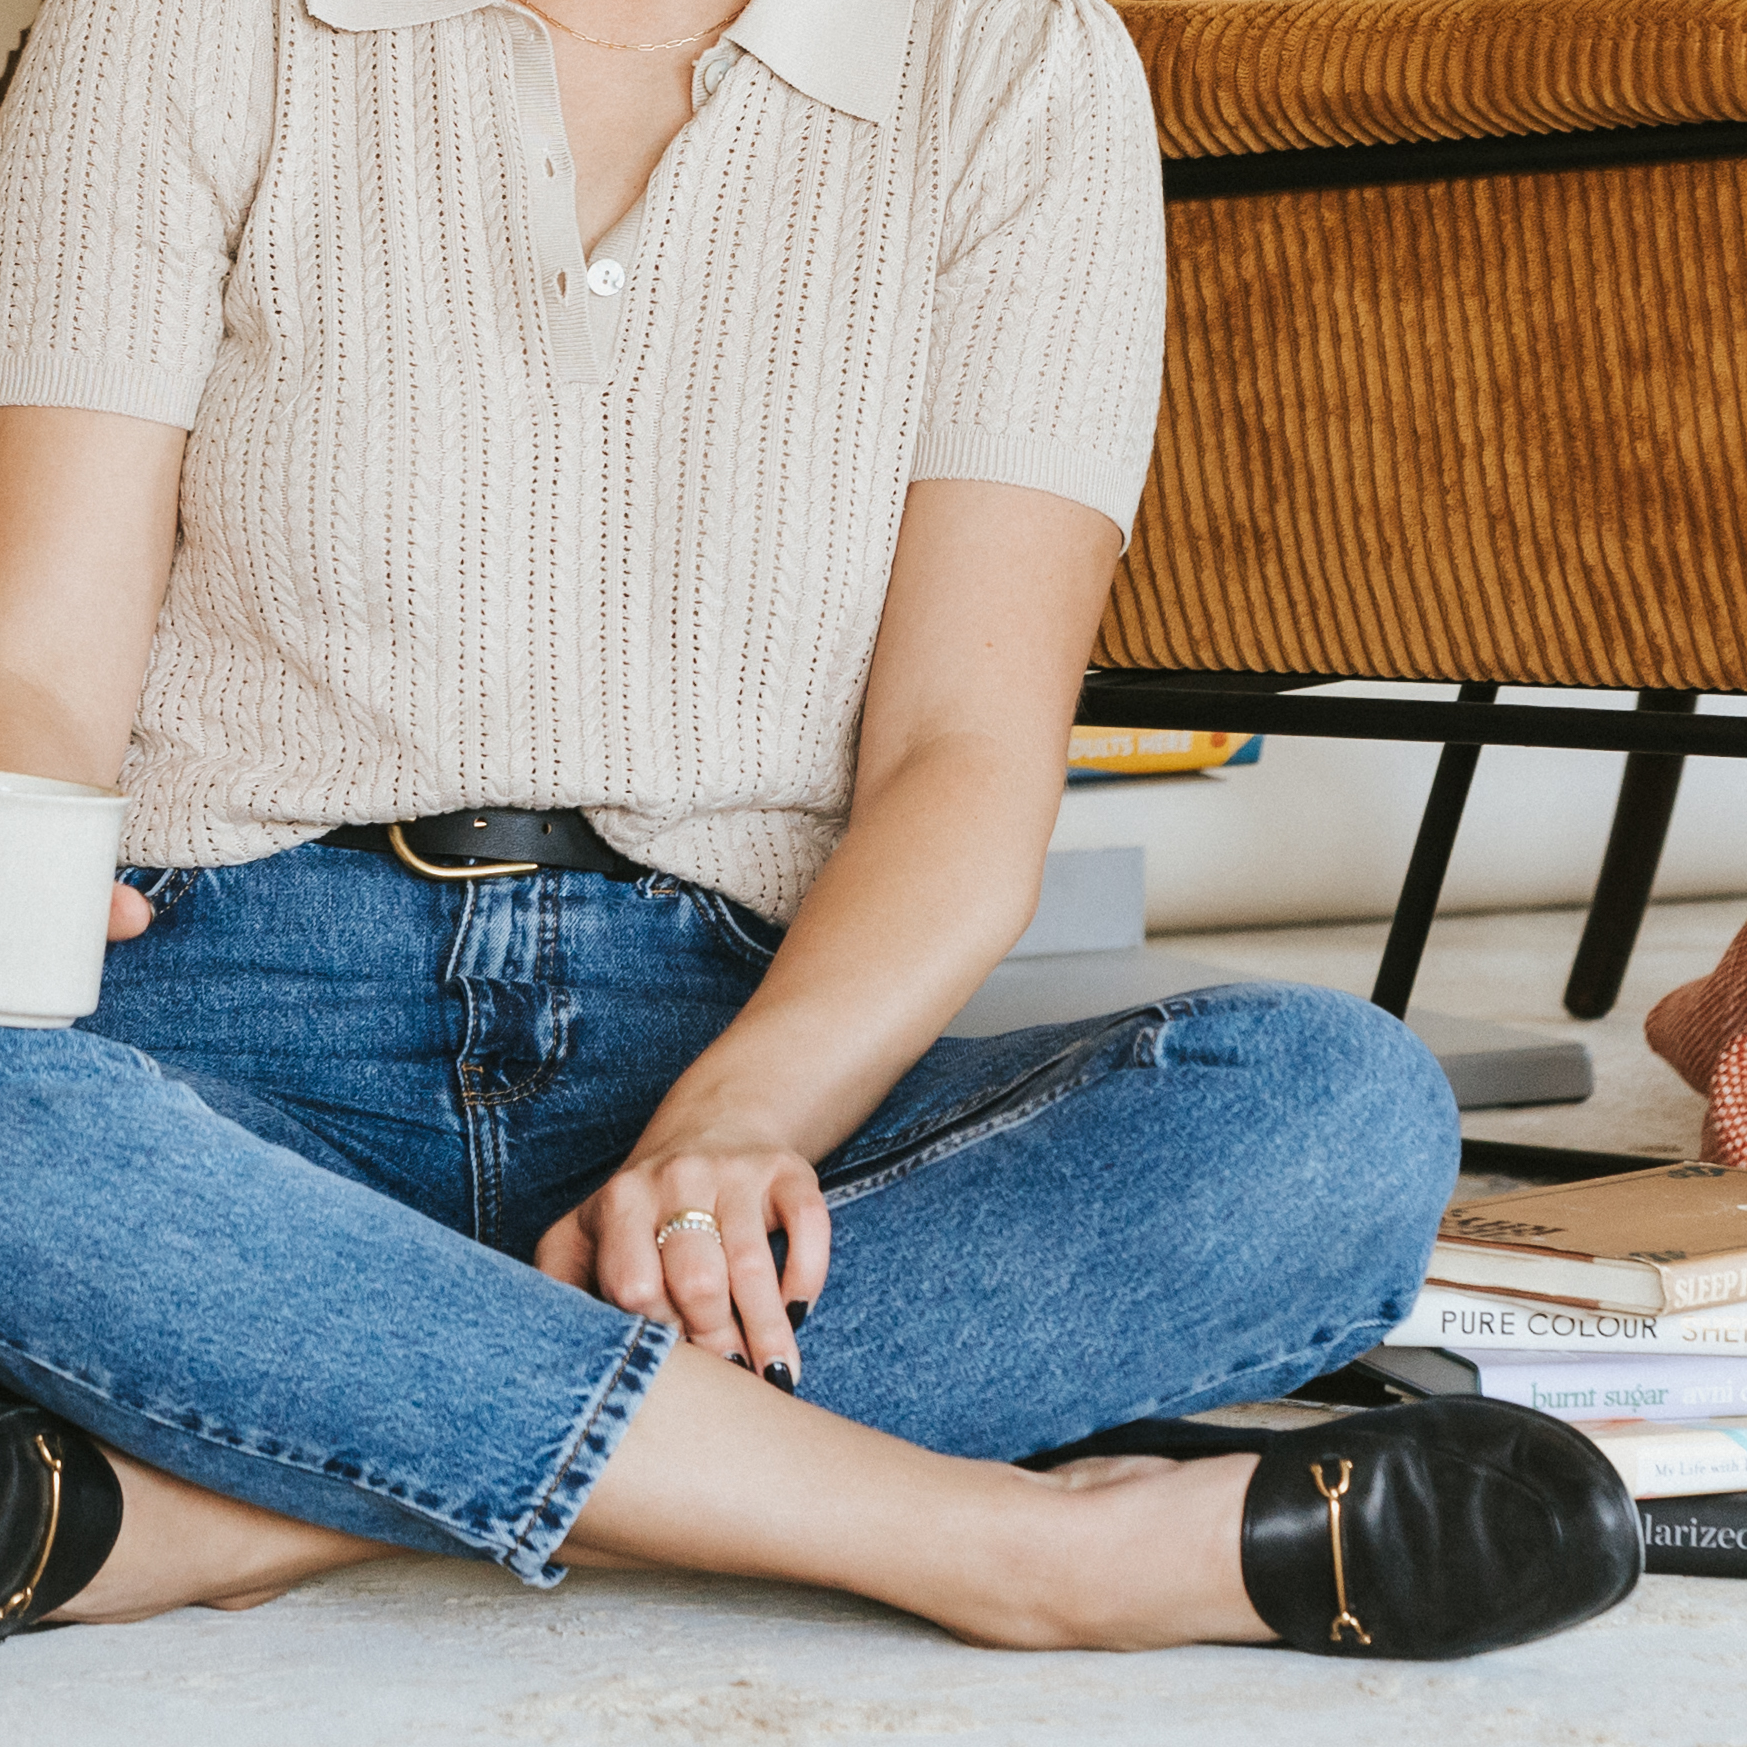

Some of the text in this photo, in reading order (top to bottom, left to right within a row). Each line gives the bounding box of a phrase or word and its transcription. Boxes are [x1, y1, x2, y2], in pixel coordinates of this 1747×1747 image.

[1673, 1266, 1738, 1310] SLEEP
[1441, 1310, 1516, 1336] PURE
[1527, 1311, 1659, 1340] COLOUR
[1530, 1381, 1598, 1412] burnt
[1602, 1386, 1670, 1415] sugar
[1681, 1377, 1734, 1407] avni
[1678, 1459, 1707, 1476] Life
[1710, 1458, 1740, 1475] with
